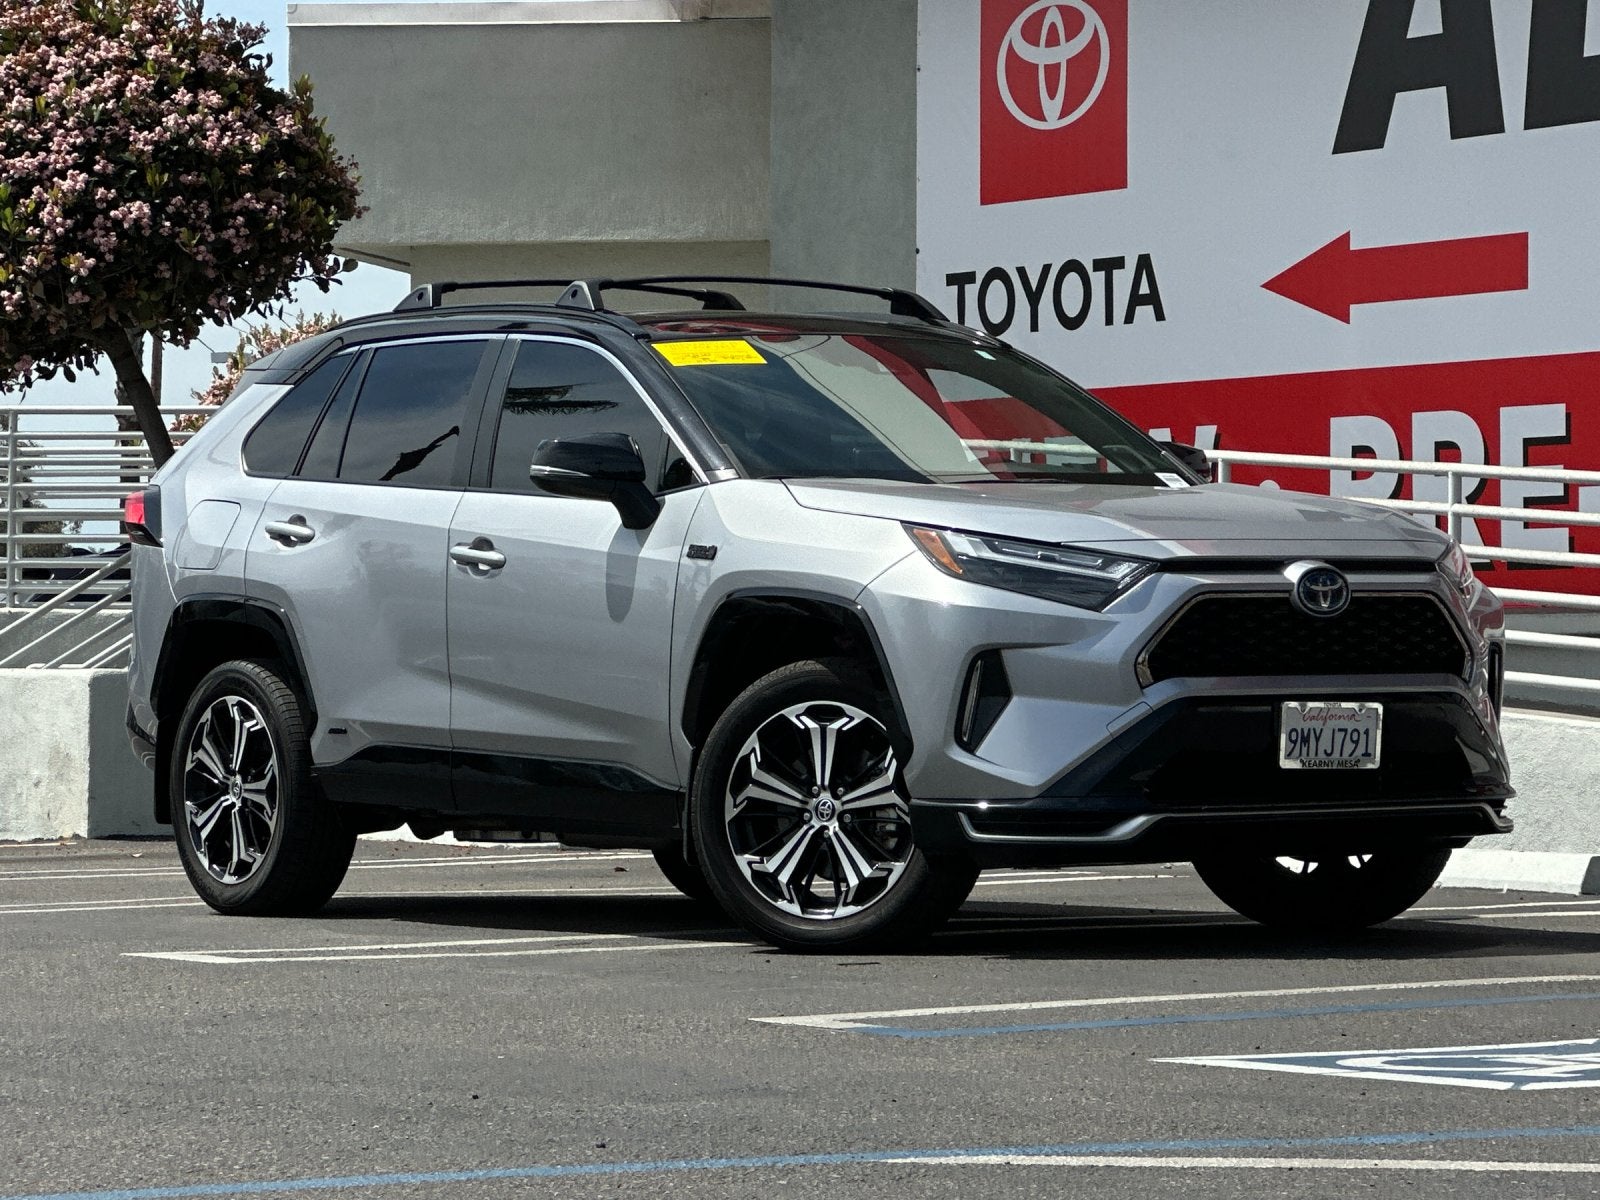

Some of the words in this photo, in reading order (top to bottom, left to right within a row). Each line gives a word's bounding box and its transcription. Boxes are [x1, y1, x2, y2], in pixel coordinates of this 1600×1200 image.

[945, 253, 1166, 337] TOYOTA
[1302, 706, 1361, 726] California
[1286, 727, 1372, 758] 9MYJ791
[1302, 759, 1334, 768] KEARNY
[1337, 759, 1359, 768] MESA
